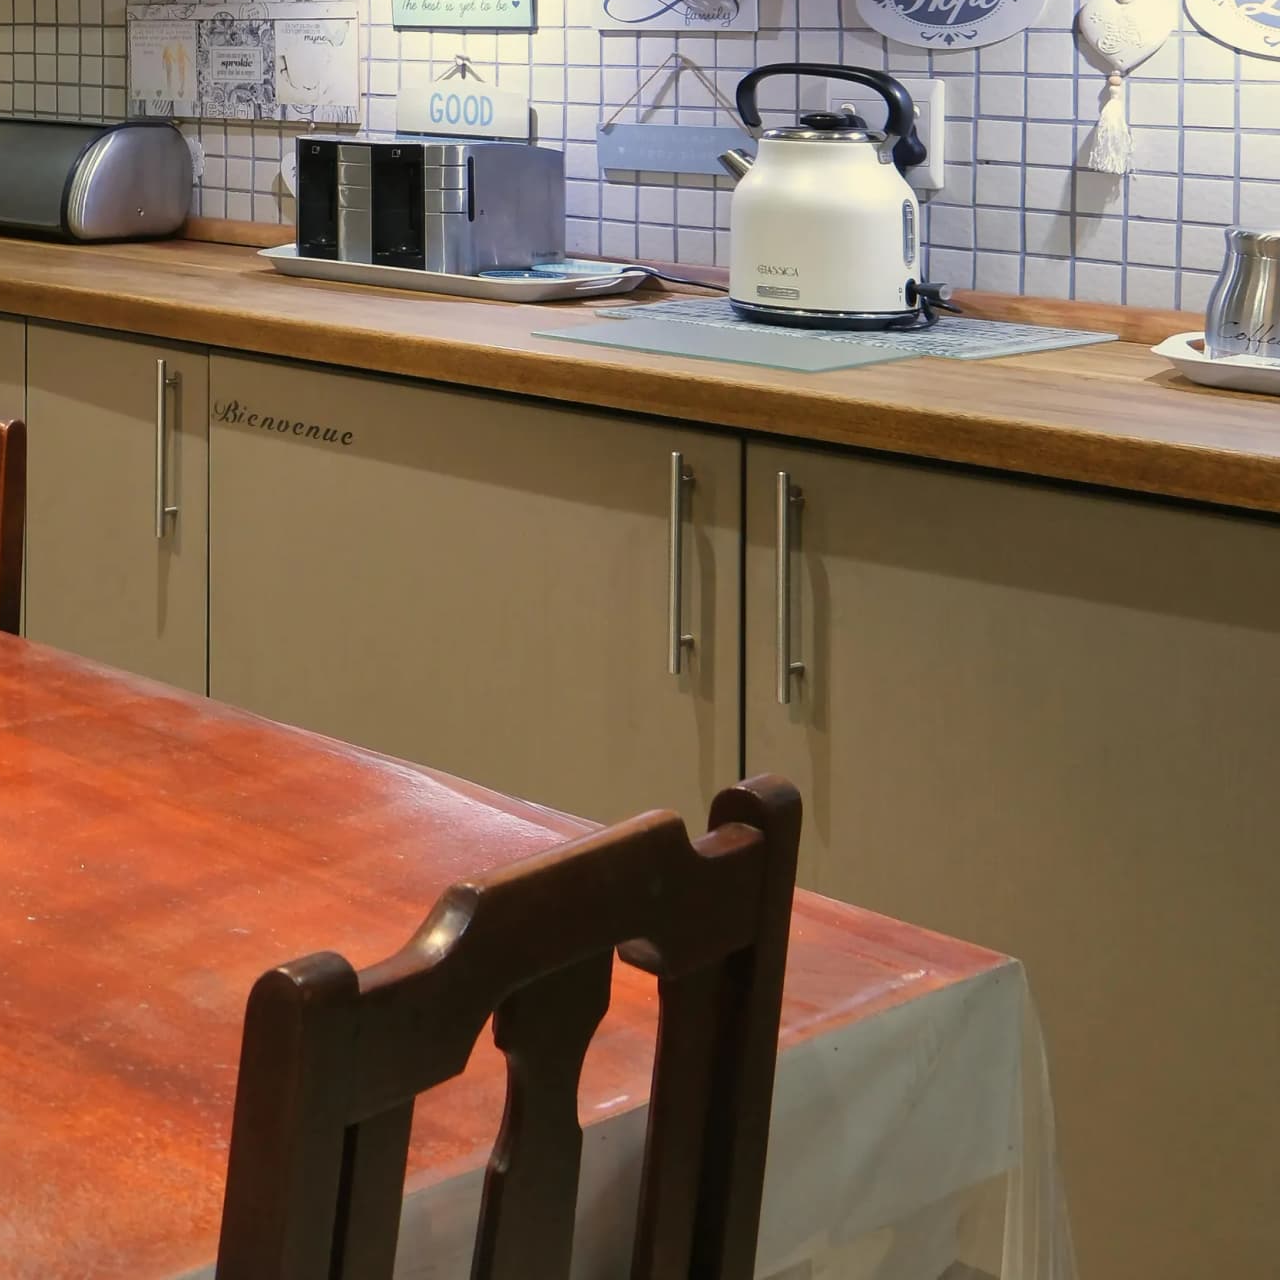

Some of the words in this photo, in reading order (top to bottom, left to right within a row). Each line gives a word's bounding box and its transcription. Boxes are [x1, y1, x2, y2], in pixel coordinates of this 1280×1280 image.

[445, 2, 455, 12] is
[459, 1, 476, 19] yet
[480, 0, 492, 12] to
[685, 5, 732, 27] family
[430, 93, 494, 126] GOOD
[1216, 321, 1280, 353] Coffe
[213, 400, 354, 446] Bienvenue
